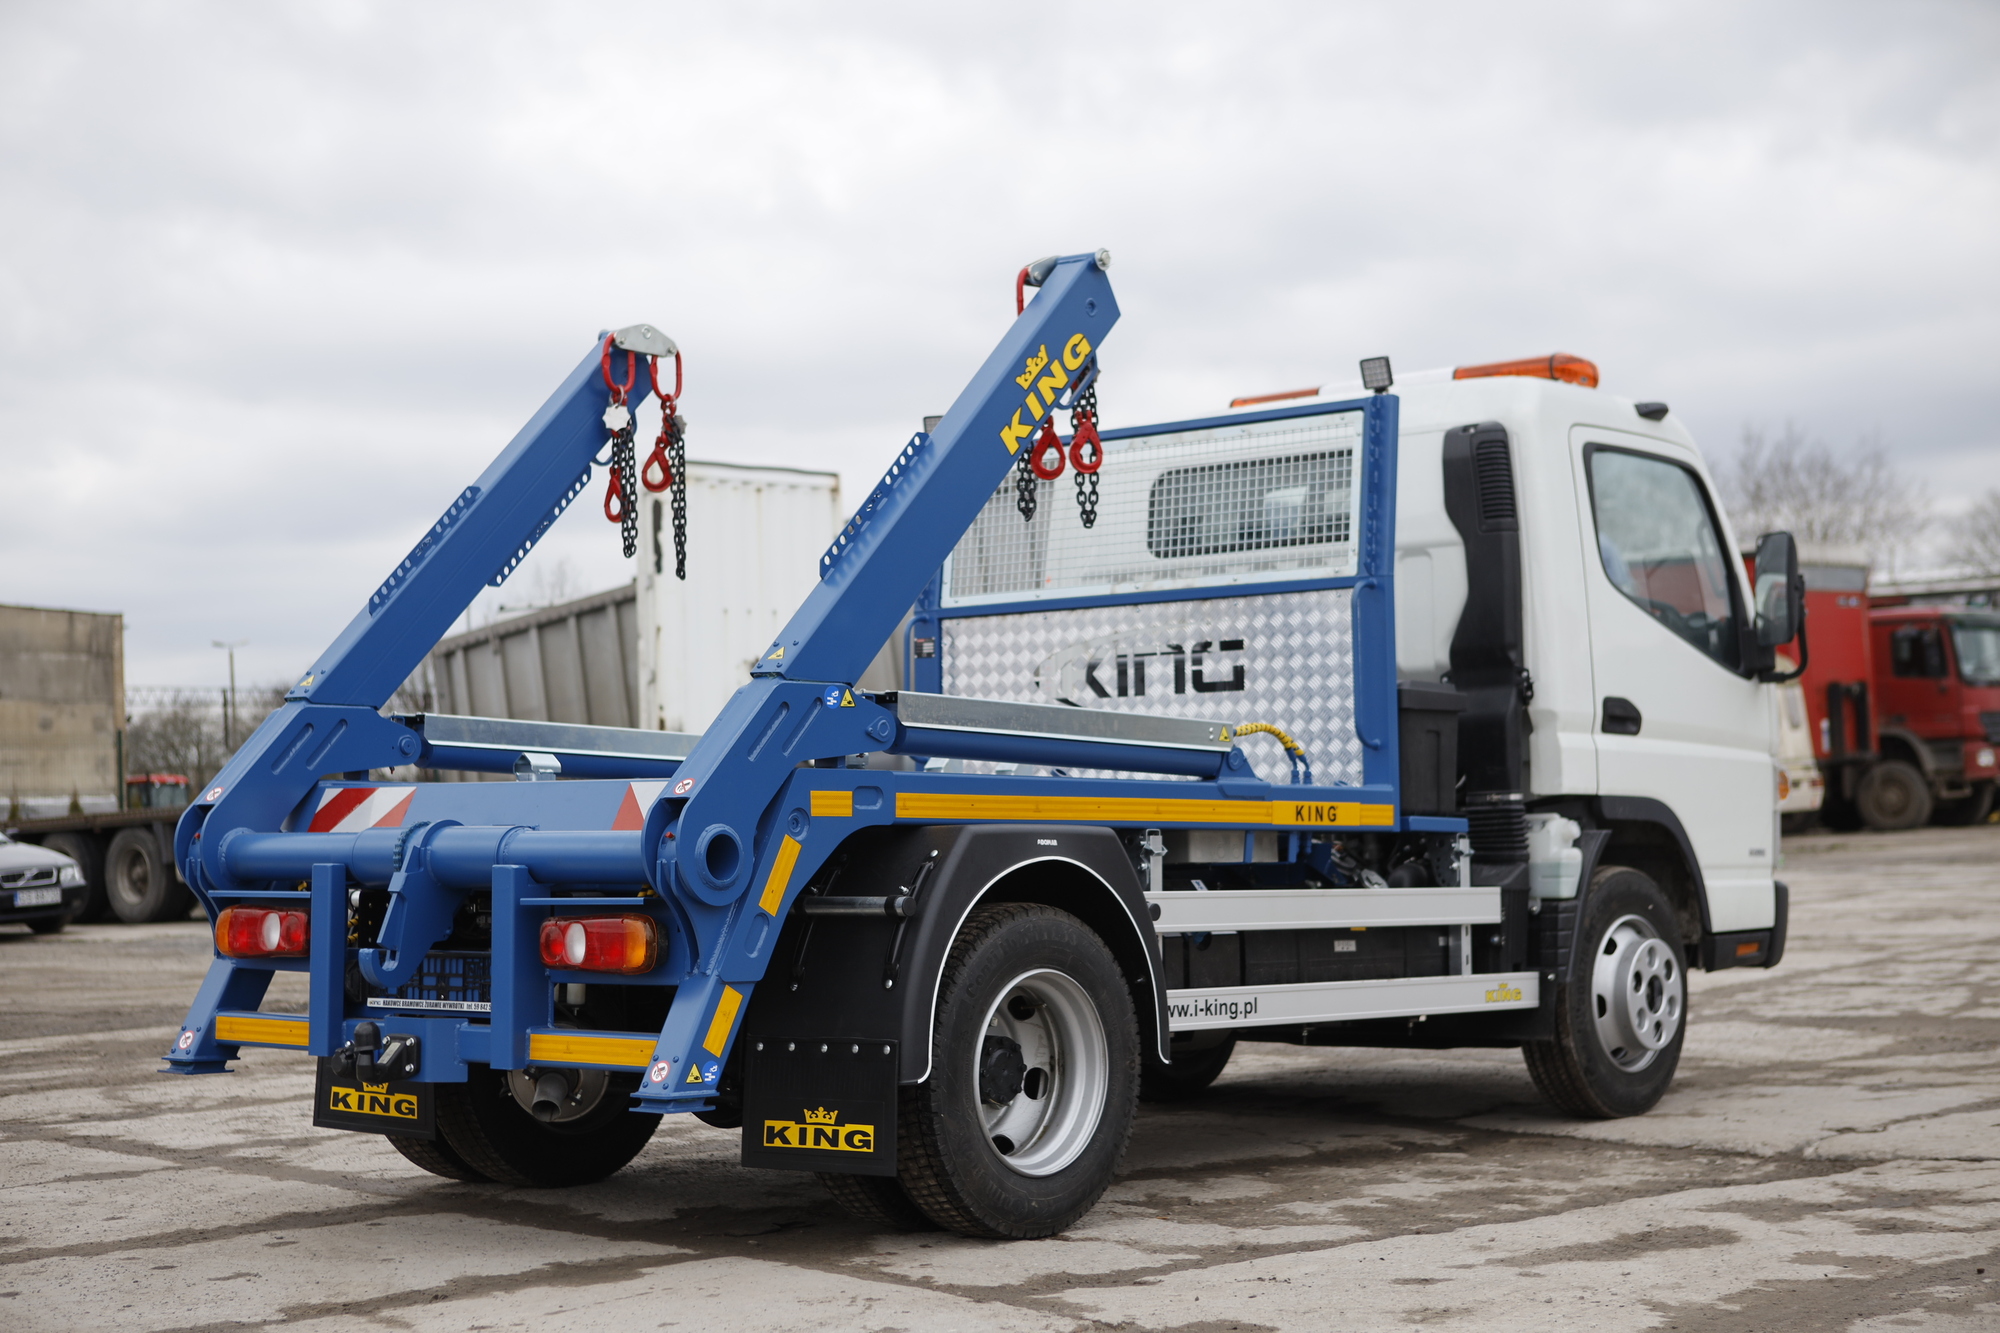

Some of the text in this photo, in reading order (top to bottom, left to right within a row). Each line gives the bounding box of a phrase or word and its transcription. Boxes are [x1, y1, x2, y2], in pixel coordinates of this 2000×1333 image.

[1000, 333, 1092, 455] KING
[1085, 637, 1245, 699] KING
[1295, 804, 1338, 823] KING
[442, 1002, 464, 1010] WYWROTKI
[1485, 988, 1522, 1003] KING
[331, 1091, 416, 1117] KING
[765, 1125, 872, 1150] KING
